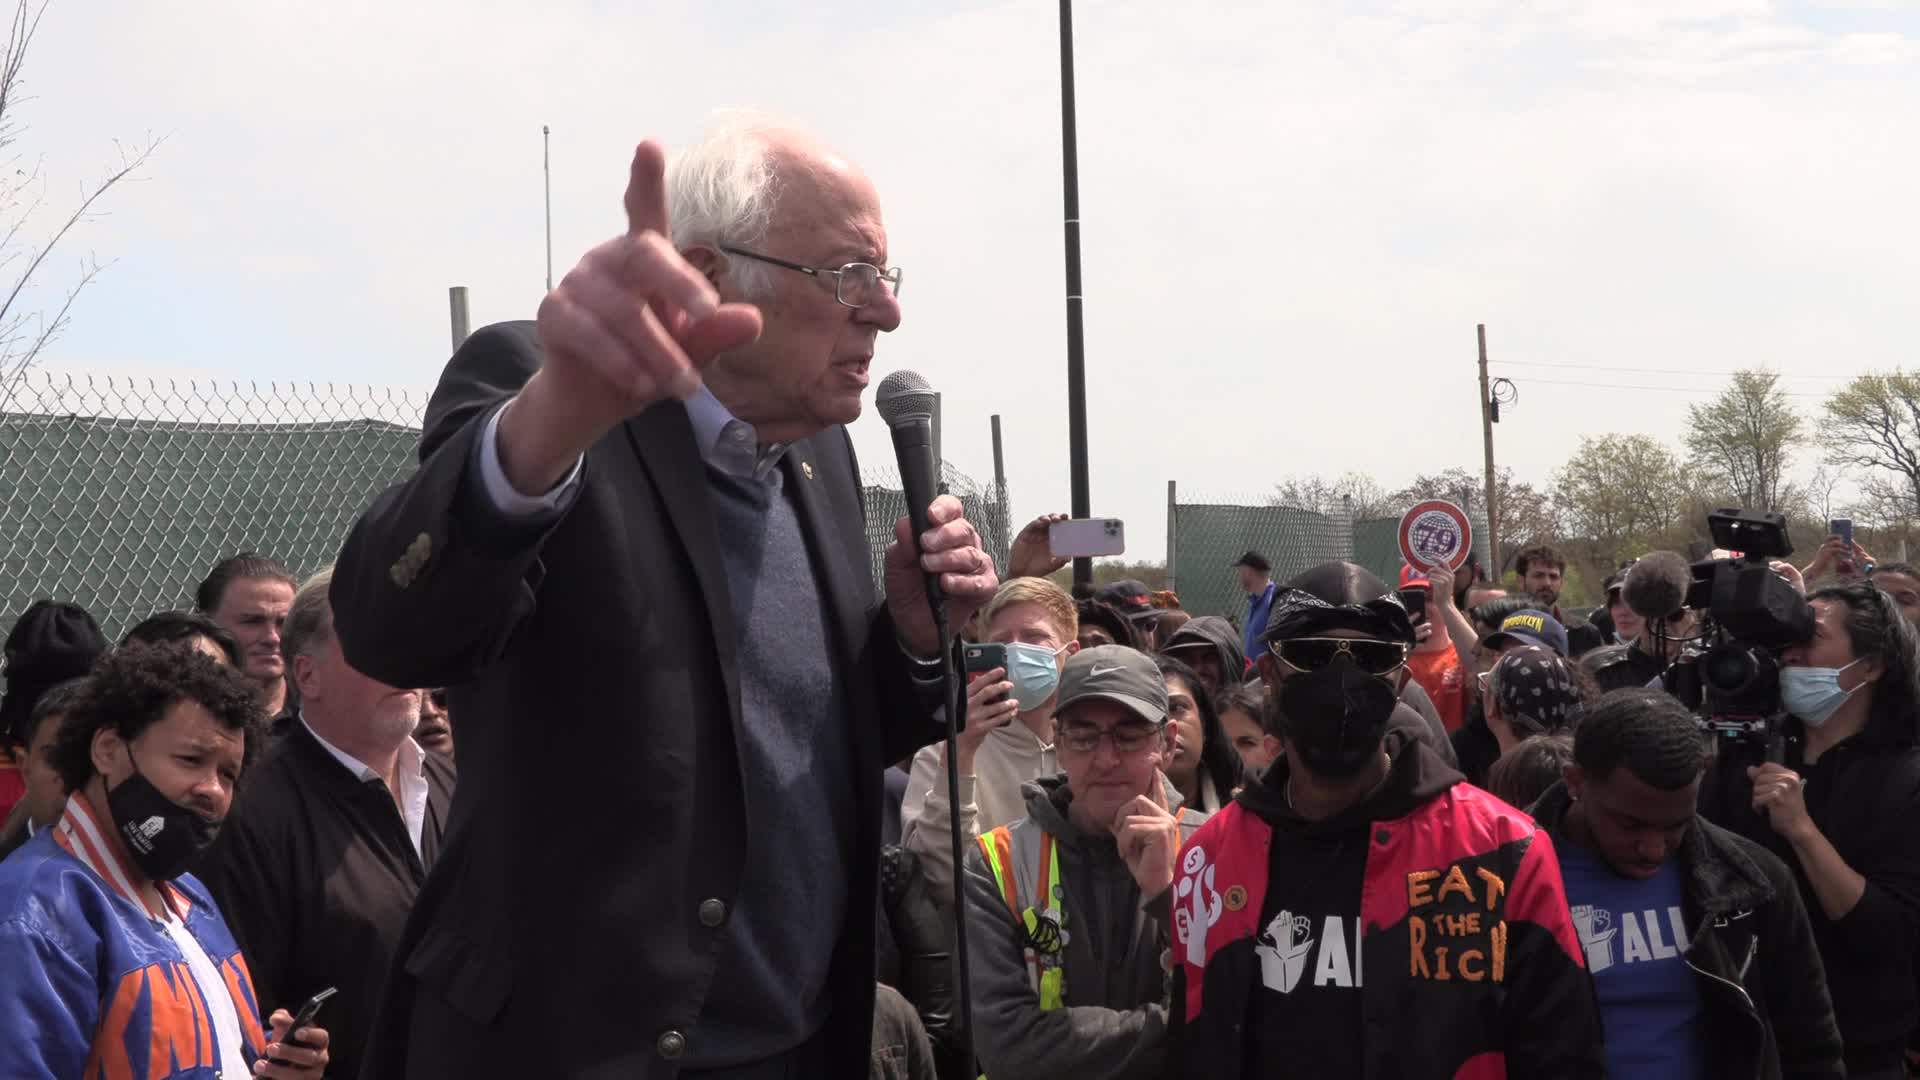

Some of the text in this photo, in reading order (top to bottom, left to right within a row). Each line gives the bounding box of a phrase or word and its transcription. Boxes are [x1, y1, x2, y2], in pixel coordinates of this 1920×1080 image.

[1416, 523, 1457, 554] 79
[1407, 865, 1505, 910] EAT
[1433, 912, 1481, 937] THE
[1408, 915, 1507, 983] RICH
